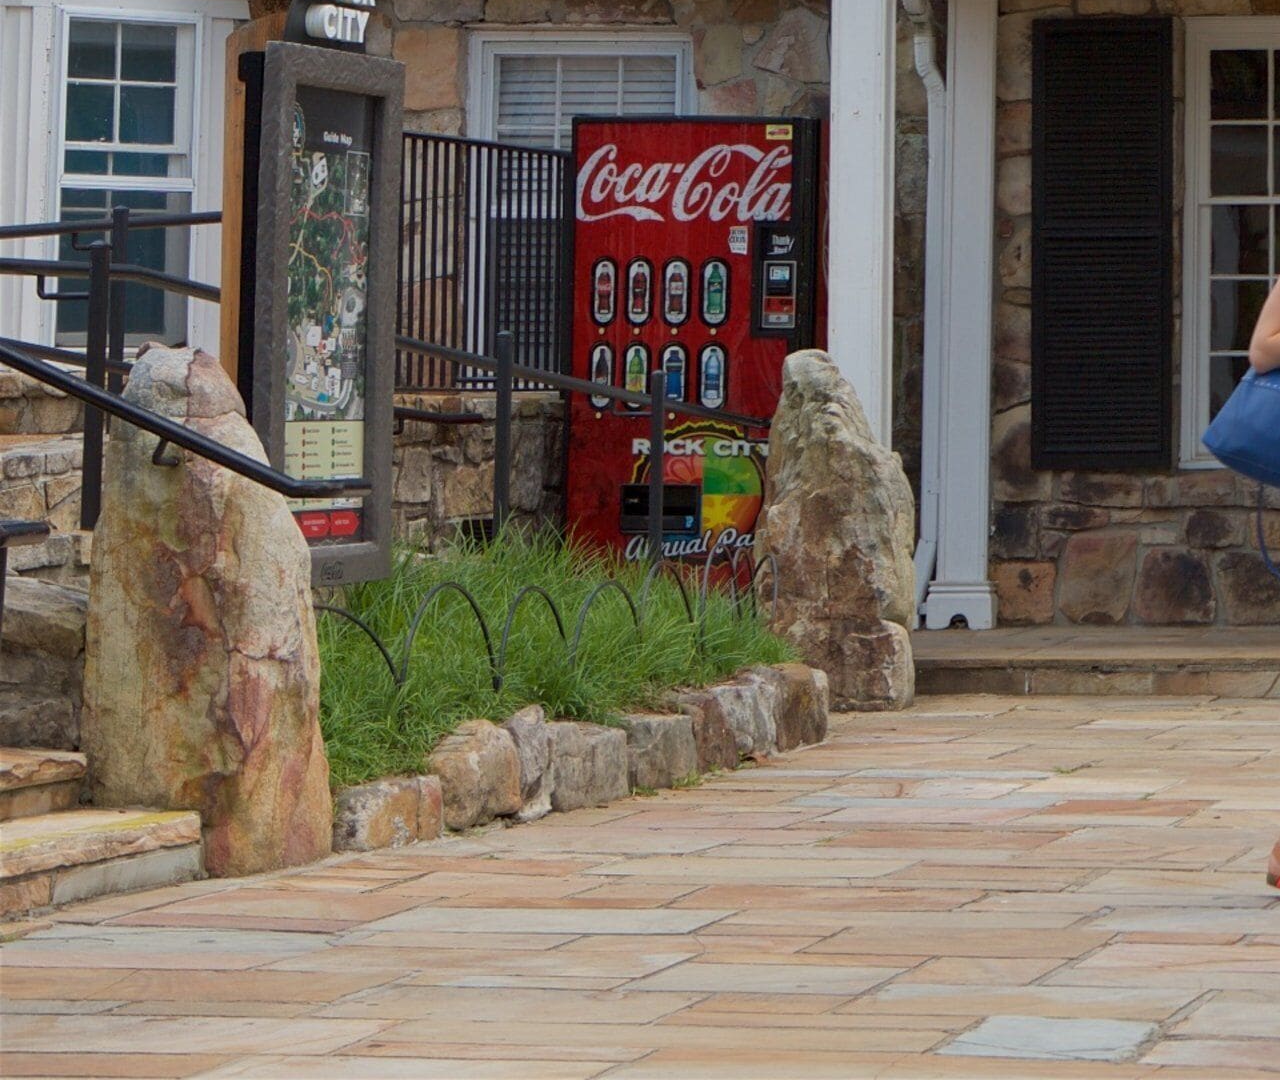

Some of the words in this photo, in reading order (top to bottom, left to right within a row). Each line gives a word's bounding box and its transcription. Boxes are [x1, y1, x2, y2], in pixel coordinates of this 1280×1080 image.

[323, 4, 370, 43] CITY
[576, 144, 792, 221] Coca-Cola
[632, 438, 705, 456] RCK
[625, 529, 712, 561] Anual
